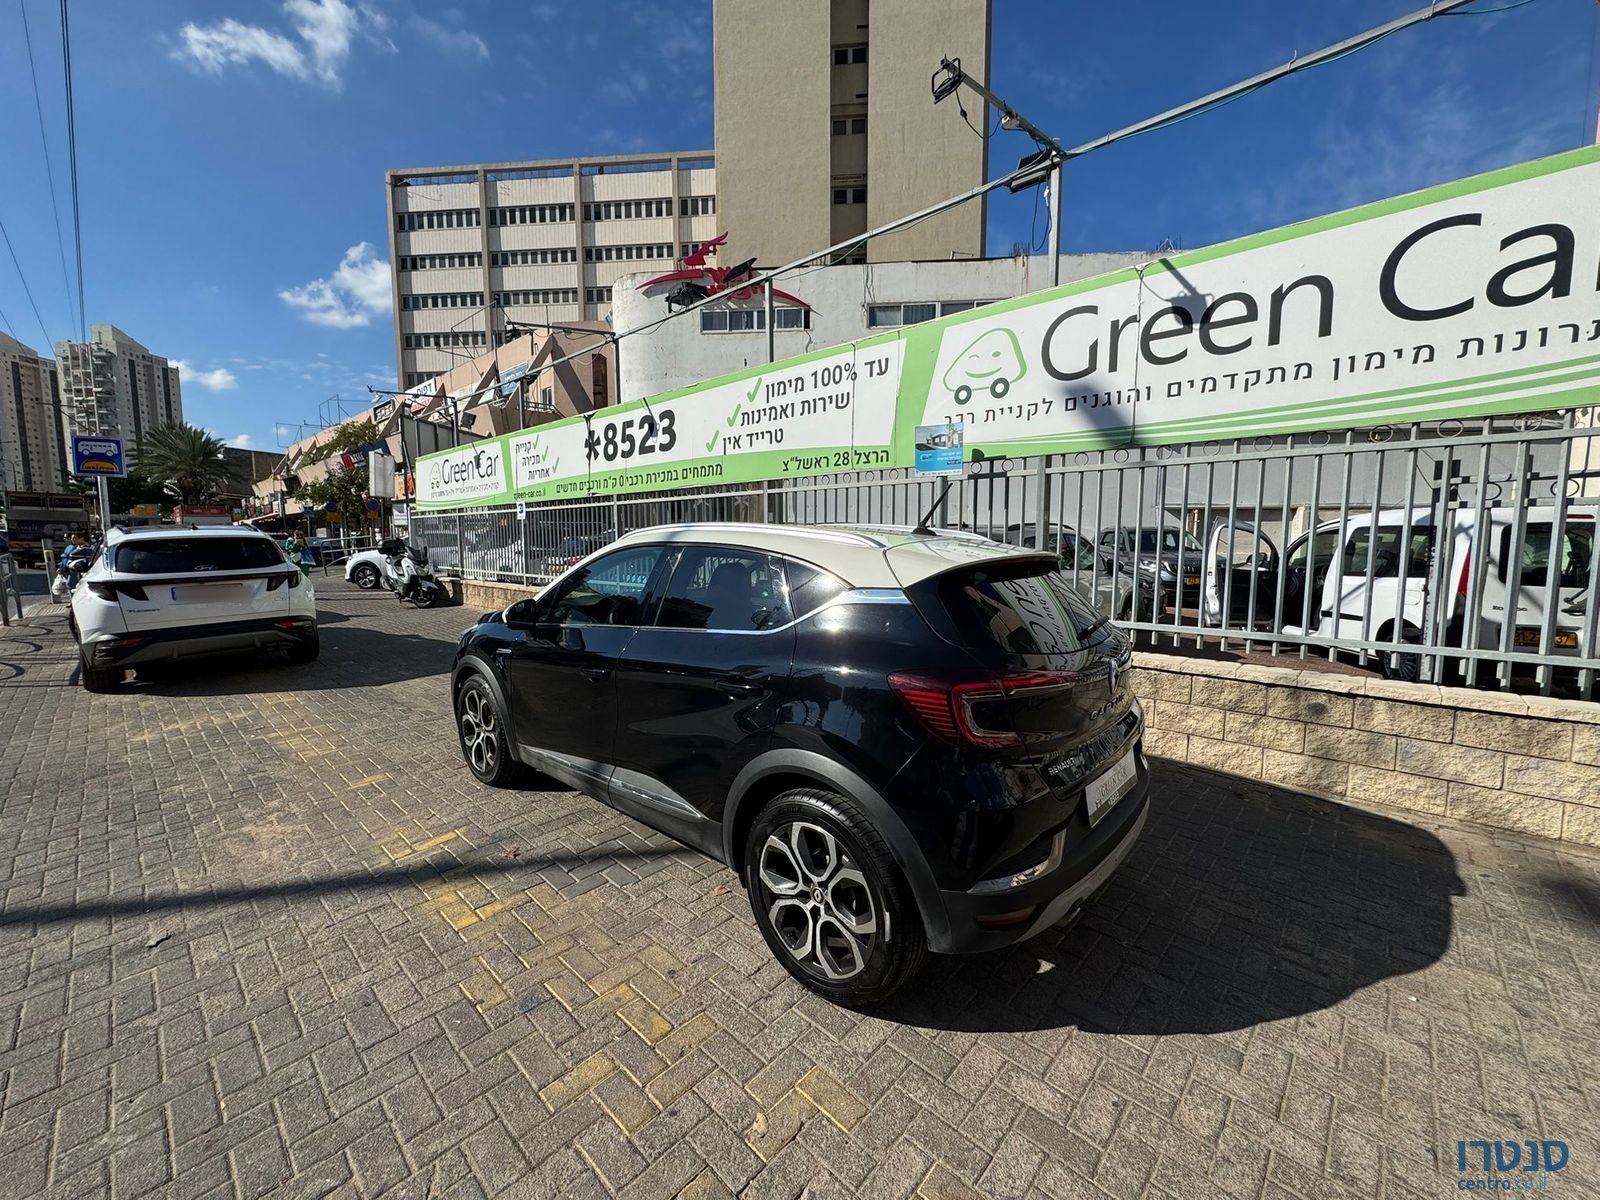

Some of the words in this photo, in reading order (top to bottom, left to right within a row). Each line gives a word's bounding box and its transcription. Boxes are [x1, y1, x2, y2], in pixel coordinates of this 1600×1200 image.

[1041, 274, 1334, 382] Green
[1379, 213, 1600, 322] Ca
[864, 357, 889, 378] עד
[1332, 343, 1435, 381] מימון
[811, 363, 858, 388] 100%
[1167, 362, 1313, 398] מתקדמים
[765, 376, 805, 403] מימון
[1065, 385, 1151, 411] והוגנים
[740, 404, 795, 426] ואמינות
[800, 392, 851, 416] שירות
[984, 397, 1053, 423] לקניית
[722, 434, 741, 455] אין
[746, 428, 784, 448] טרייד
[442, 459, 474, 485] Green
[477, 450, 498, 479] Car
[834, 452, 850, 467] 28
[854, 450, 889, 465] הרצל
[625, 475, 644, 487] רכבי
[646, 471, 679, 485] במכירת
[682, 463, 723, 480] מתמחים
[556, 482, 578, 494] חדשים
